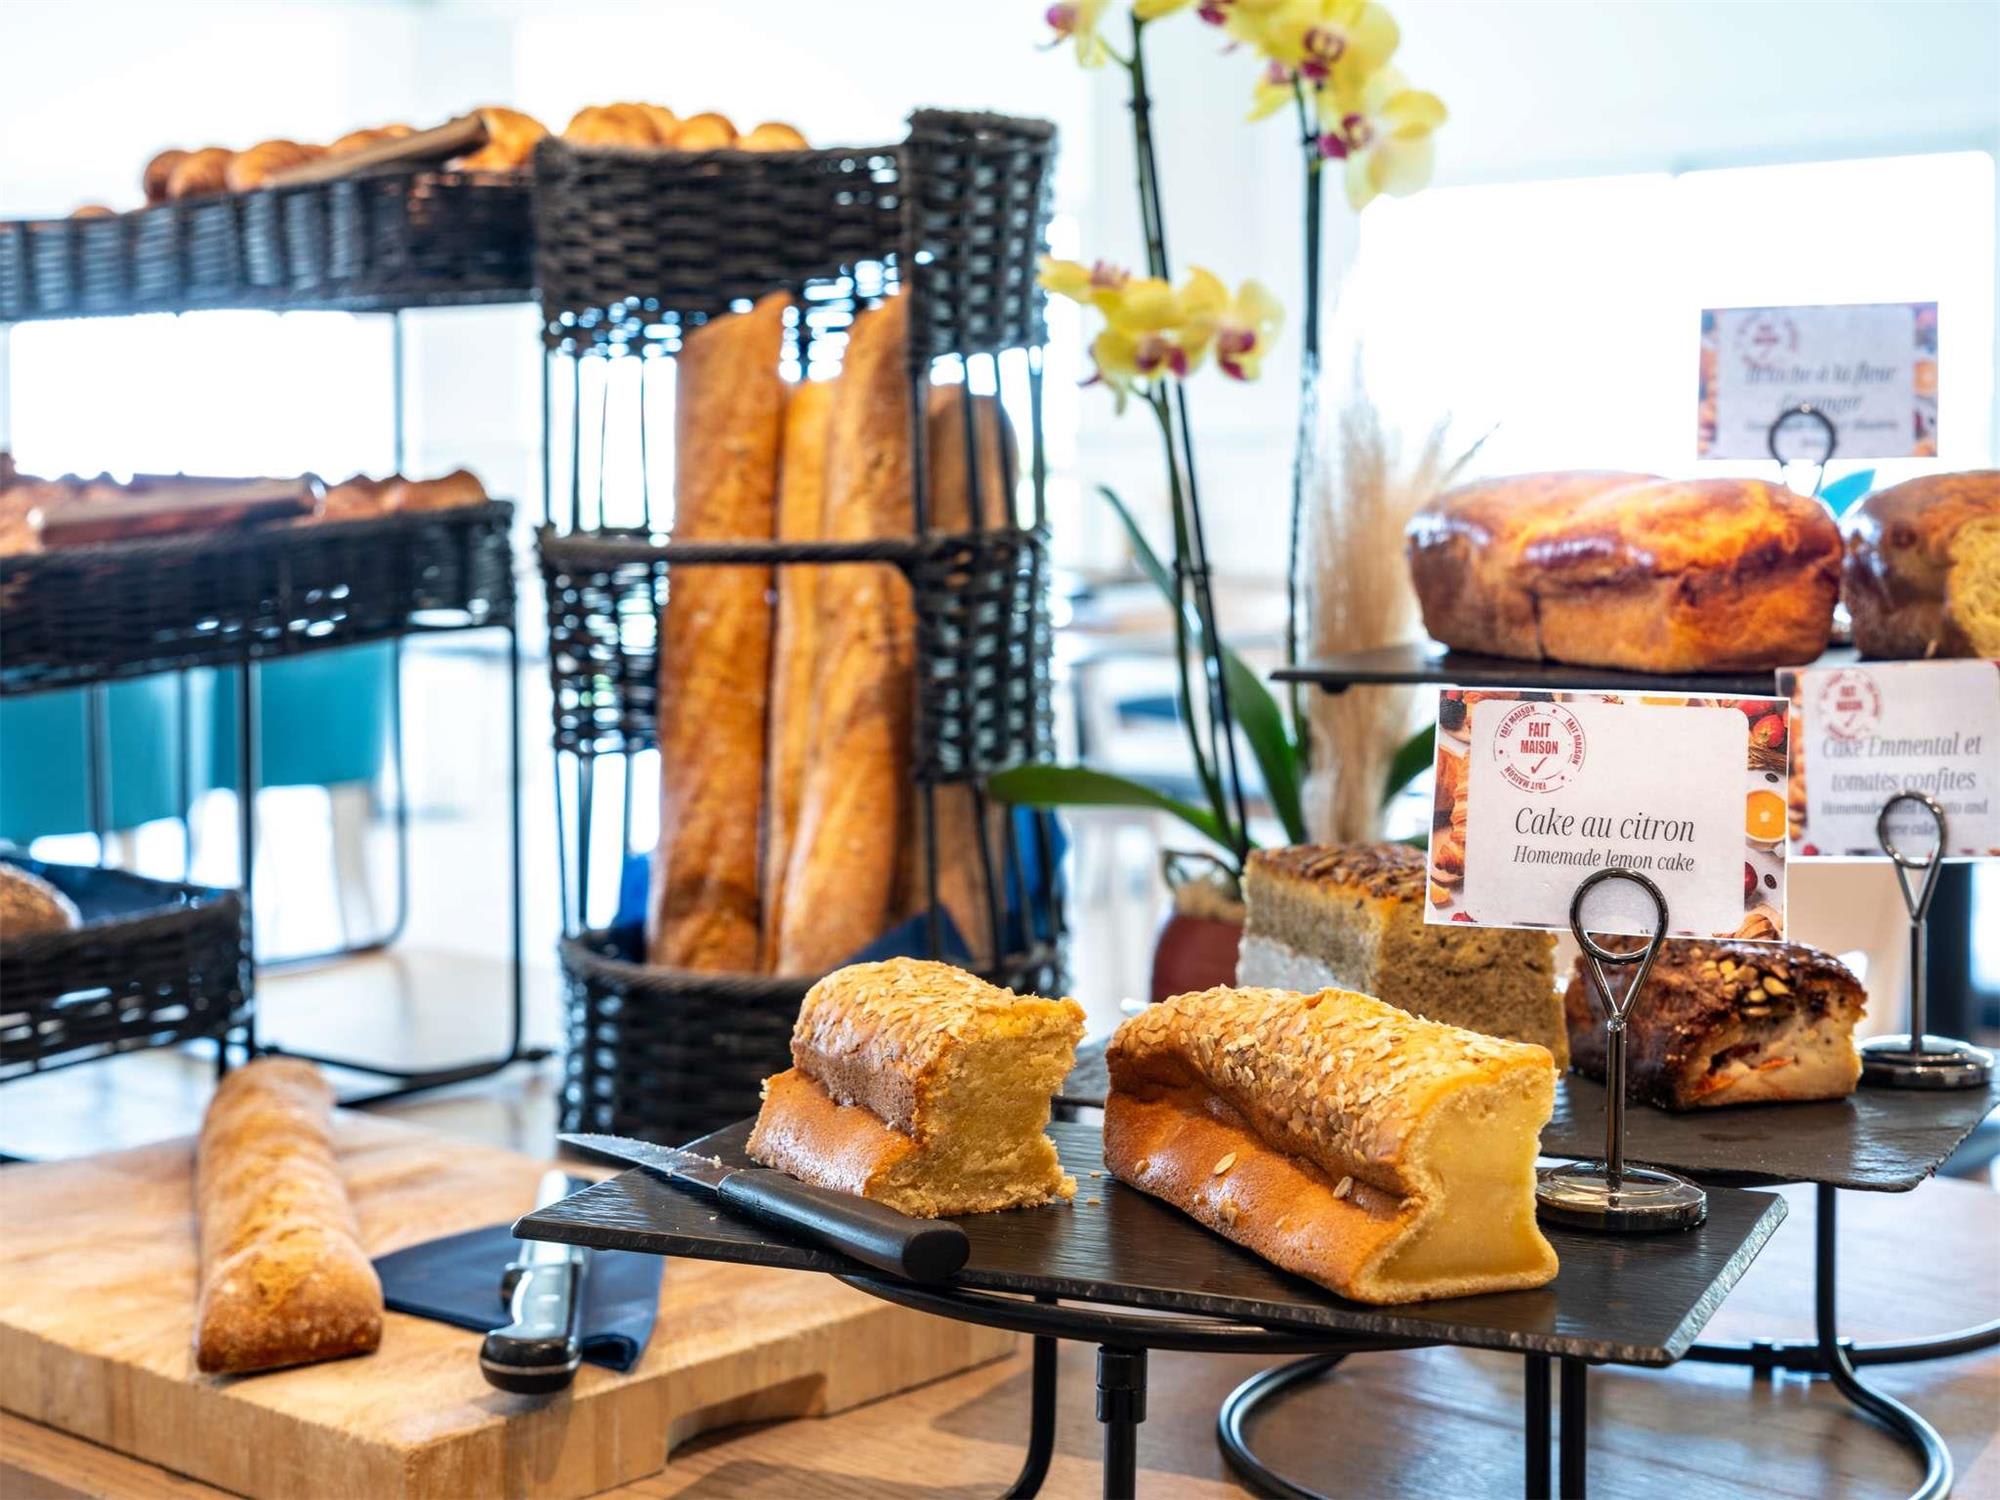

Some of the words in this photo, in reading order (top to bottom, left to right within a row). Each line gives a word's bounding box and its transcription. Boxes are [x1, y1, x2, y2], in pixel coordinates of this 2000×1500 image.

[1508, 704, 1536, 724] MAISON
[1528, 722, 1551, 738] FAIT
[1520, 739, 1559, 755] MAISON
[1822, 736, 1864, 758] Cake
[1868, 732, 1959, 758] Emmental
[1964, 735, 1982, 755] et
[1831, 773, 1898, 793] tomates
[1904, 767, 1977, 795] confites
[1515, 807, 1575, 836] Cake
[1581, 816, 1612, 838] au
[1620, 812, 1695, 842] citron
[1513, 845, 1600, 867] Homemade
[1605, 850, 1652, 870] lemon
[1657, 853, 1695, 872] cake
